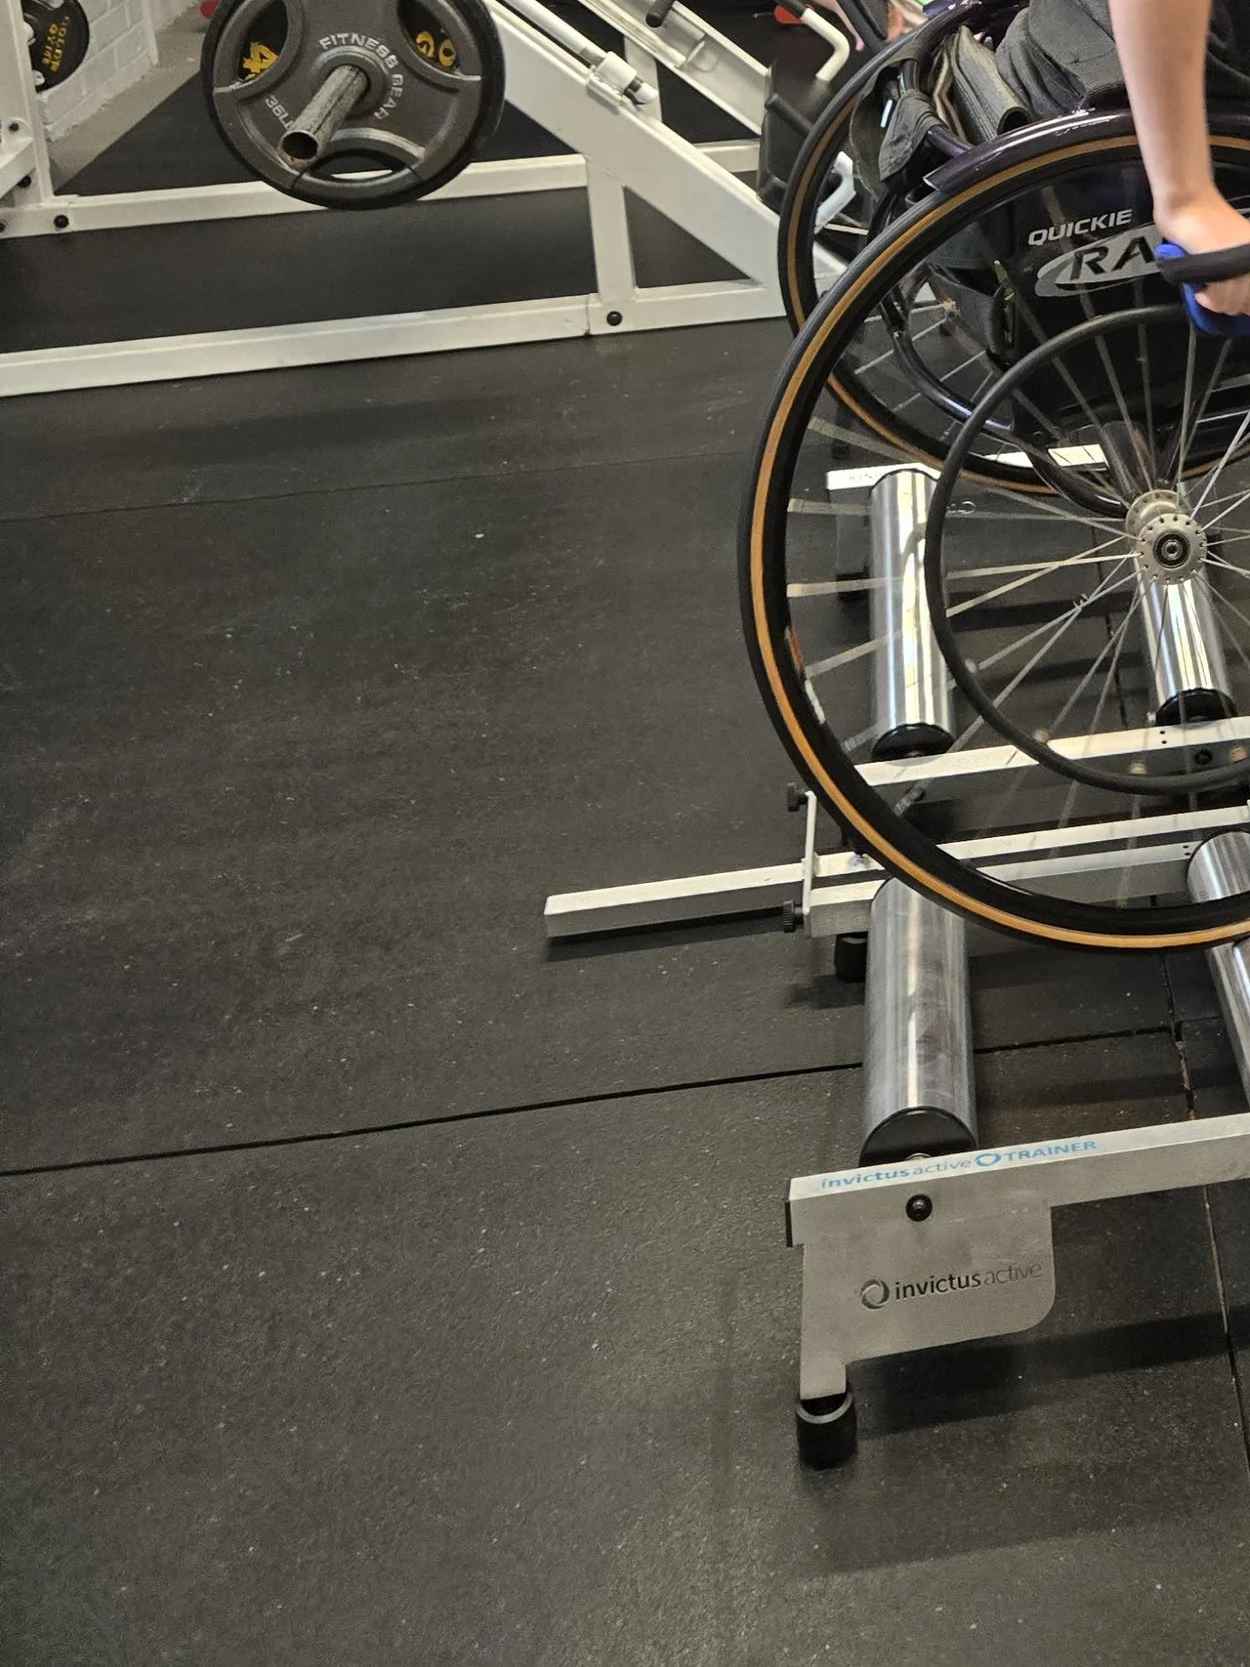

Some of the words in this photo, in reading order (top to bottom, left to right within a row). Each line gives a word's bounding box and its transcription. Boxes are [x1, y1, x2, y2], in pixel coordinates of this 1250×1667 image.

[318, 33, 400, 68] FITNESS
[374, 73, 404, 121] GEAR
[1028, 209, 1133, 246] QUICKIE
[1004, 1140, 1097, 1162] TRAINER
